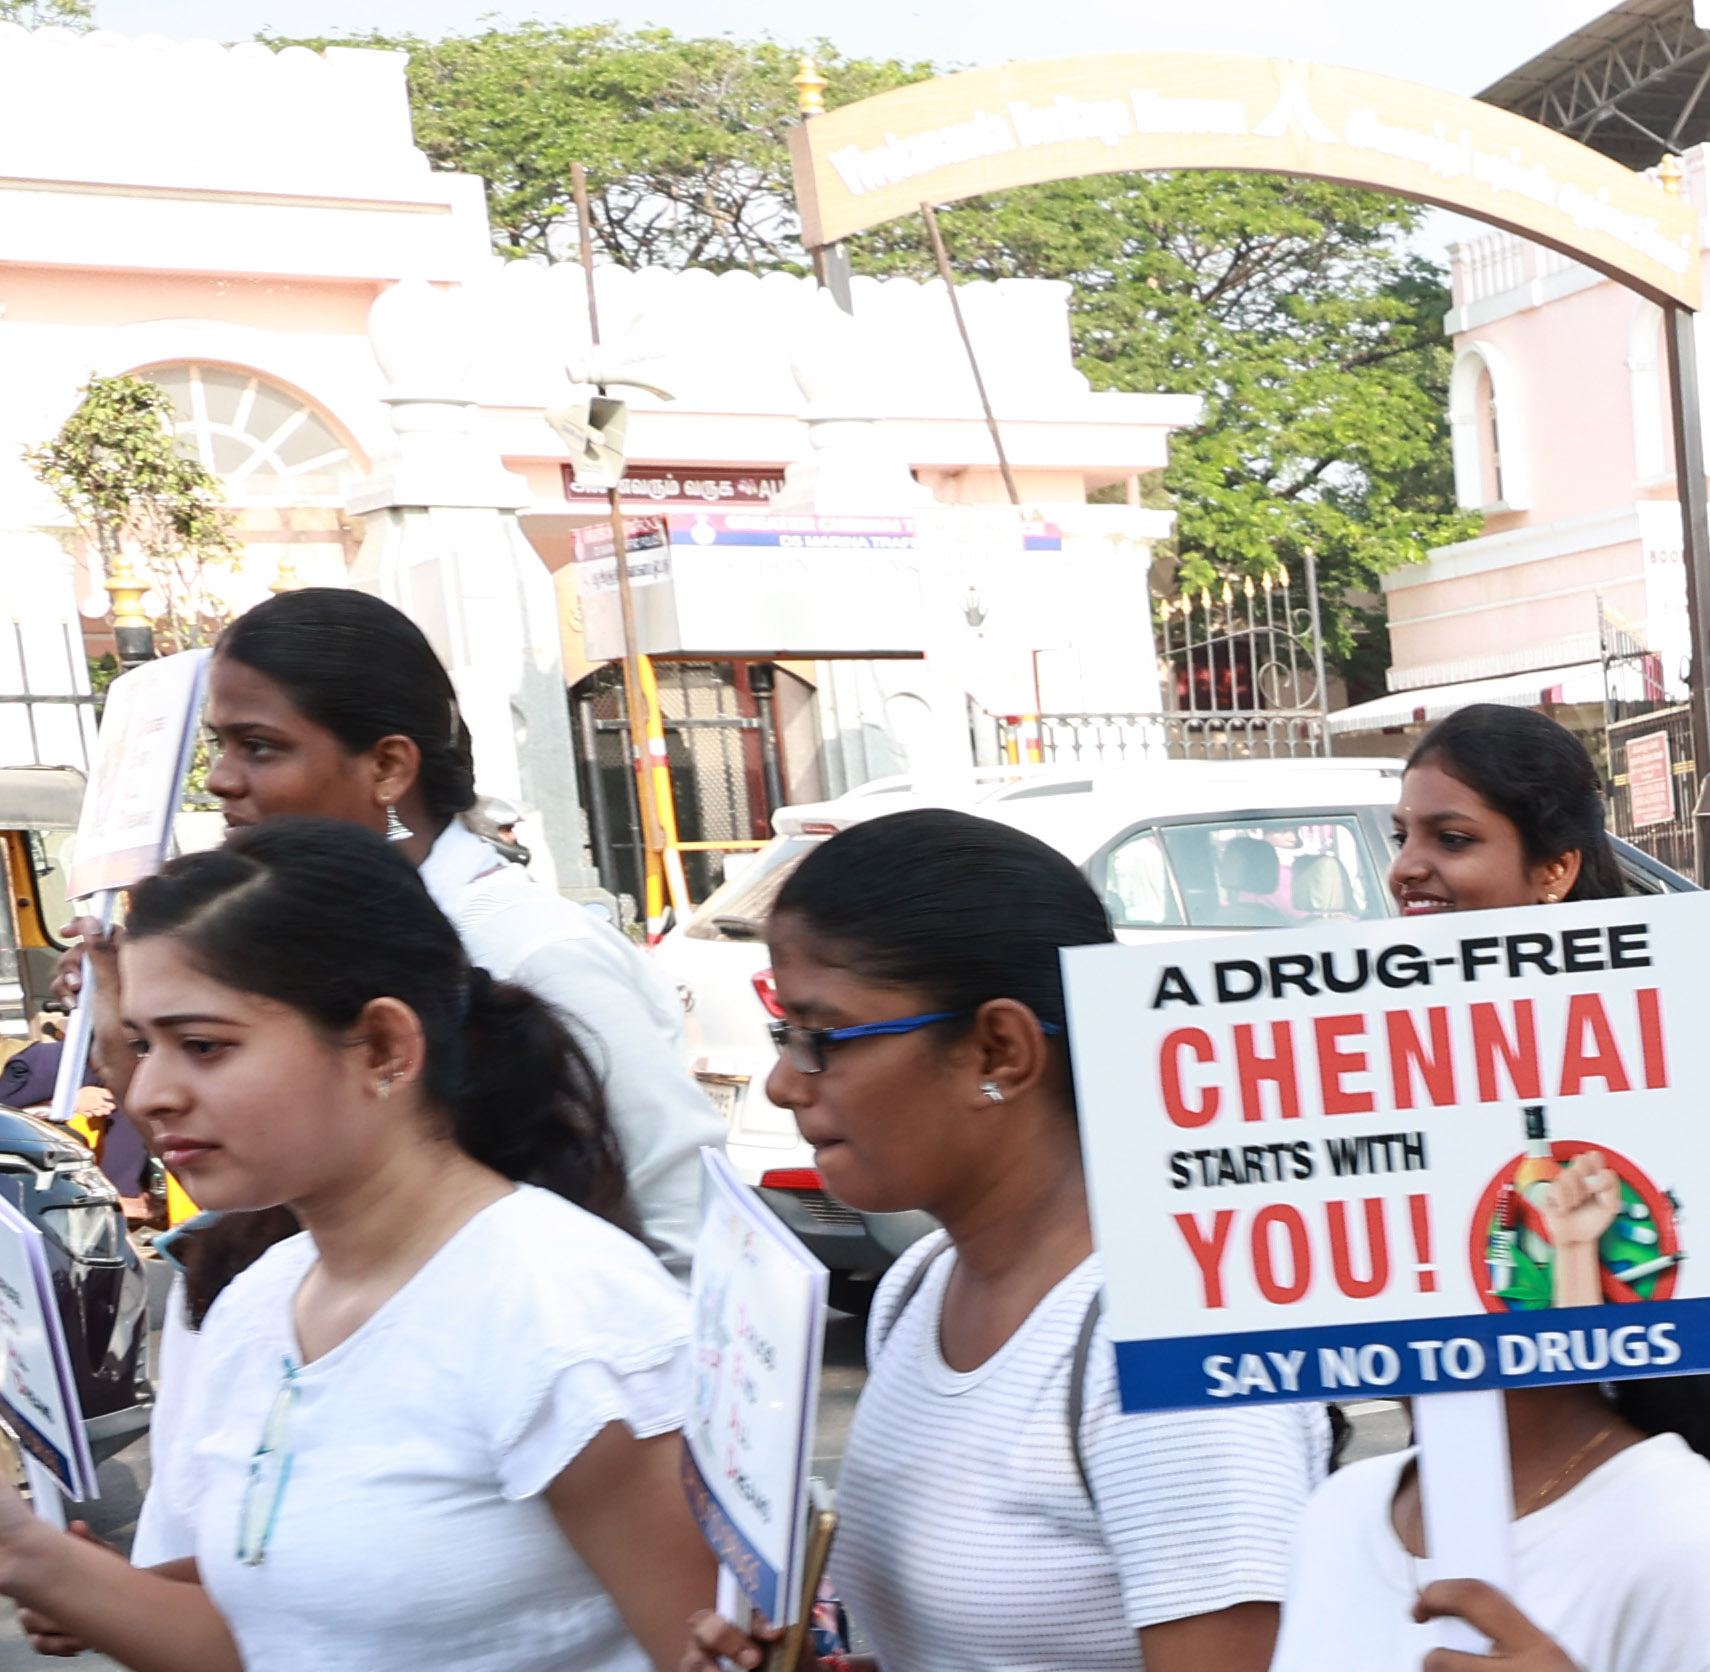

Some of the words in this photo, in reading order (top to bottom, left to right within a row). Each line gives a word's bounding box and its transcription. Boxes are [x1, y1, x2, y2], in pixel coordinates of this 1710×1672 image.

[1151, 964, 1202, 1009] A
[1213, 922, 1655, 1001] DRUG-FREE
[1157, 986, 1671, 1130] CHENNAI
[1169, 1141, 1313, 1190] STARTS
[1324, 1131, 1429, 1178] WITH
[1169, 1193, 1442, 1311] YOU!
[1200, 1351, 1308, 1399] SAY
[1318, 1342, 1401, 1389] NO
[1408, 1335, 1486, 1382] TO
[1497, 1321, 1682, 1377] DRUGS
